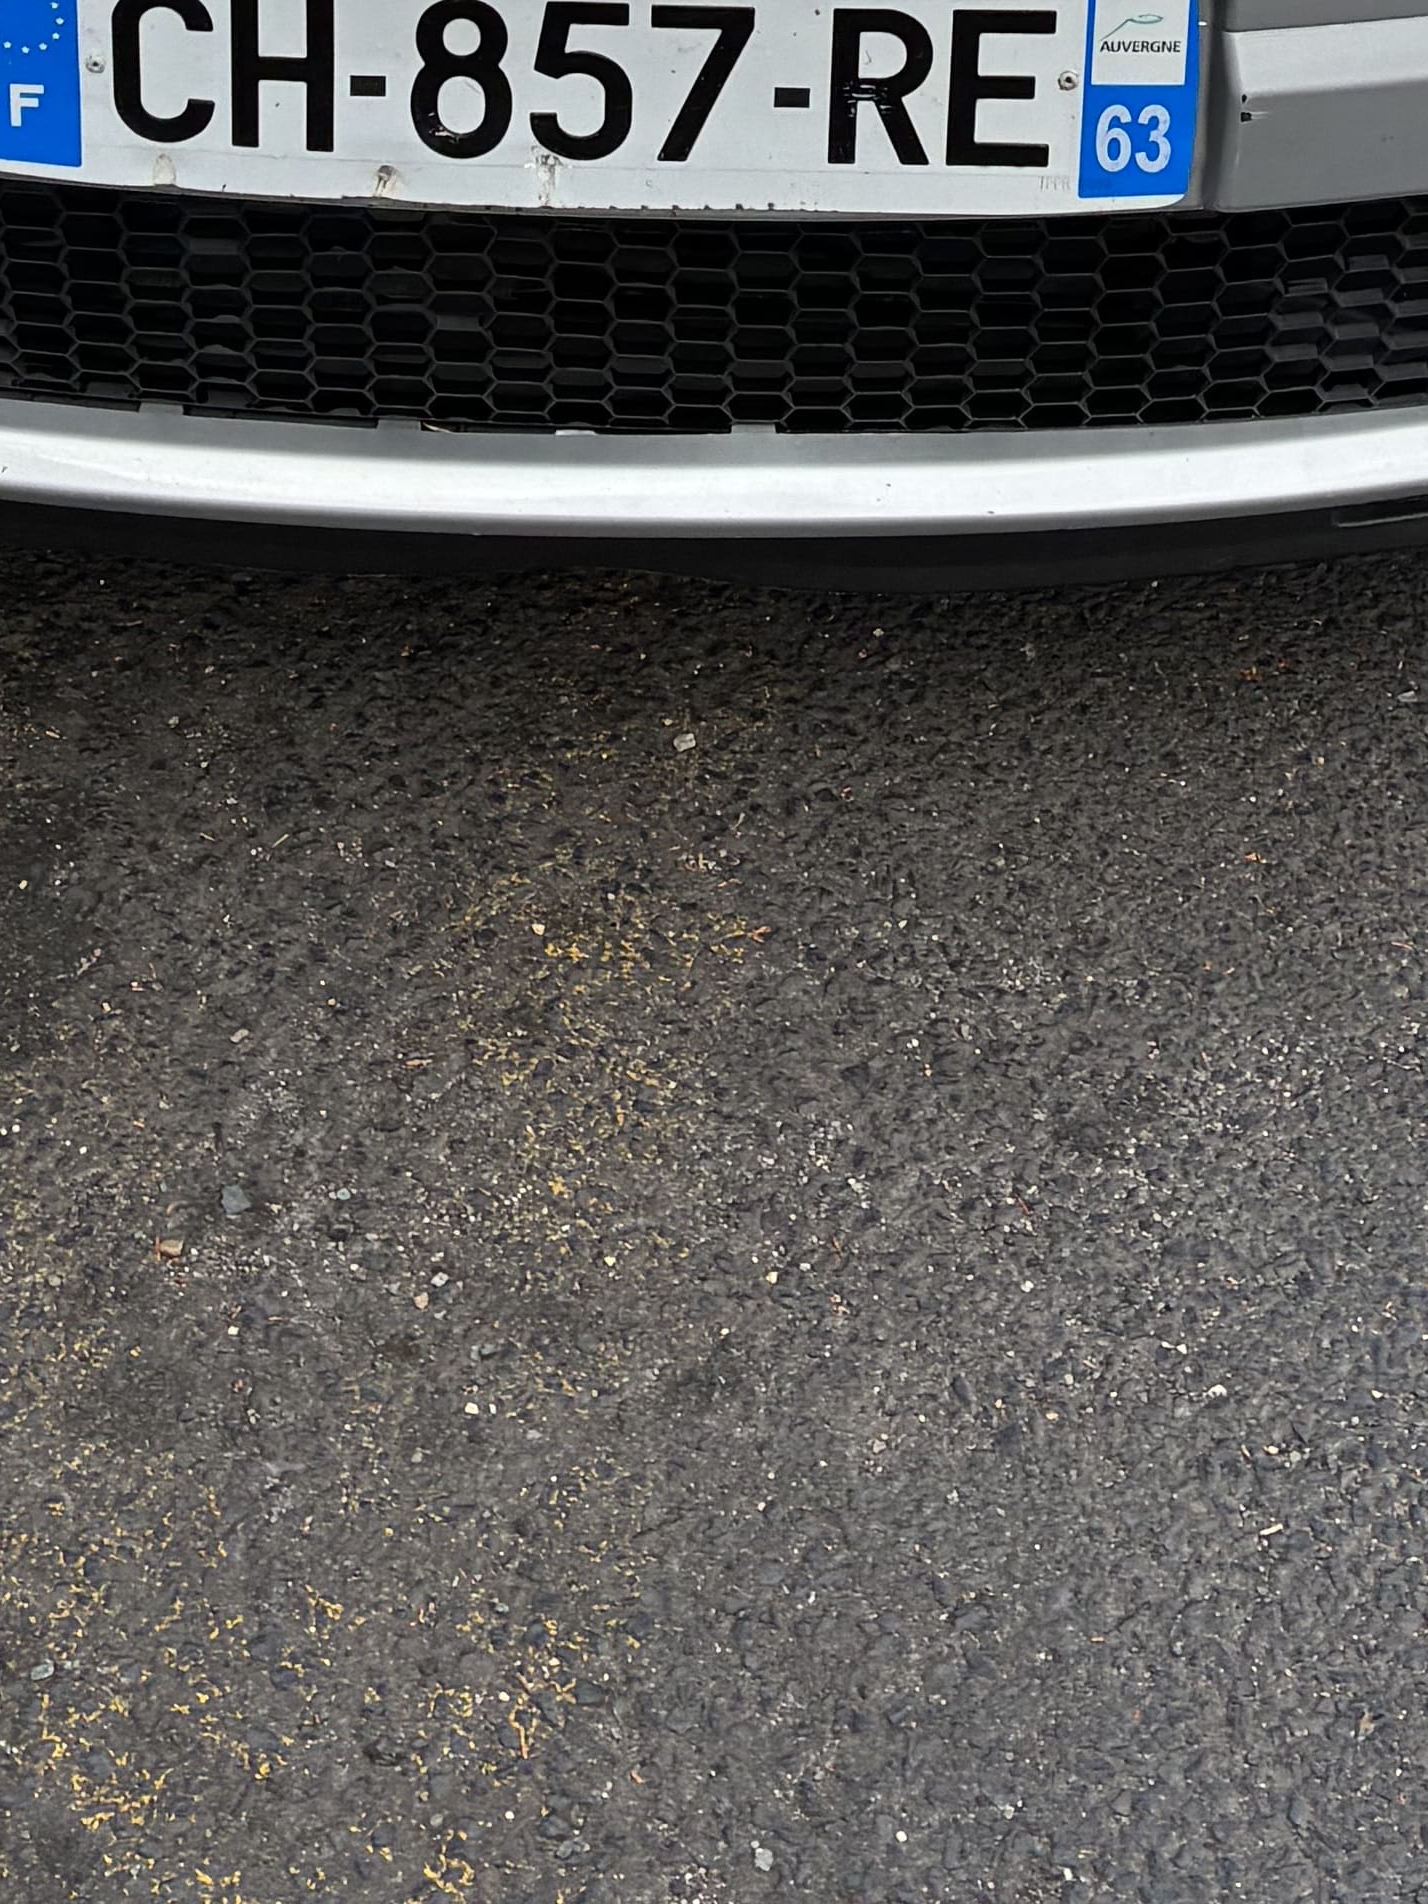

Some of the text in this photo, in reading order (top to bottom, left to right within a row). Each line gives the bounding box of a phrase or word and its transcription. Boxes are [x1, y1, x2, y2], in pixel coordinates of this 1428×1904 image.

[1100, 40, 1181, 53] AUVERGNE
[9, 83, 45, 127] F
[1095, 104, 1172, 174] 63
